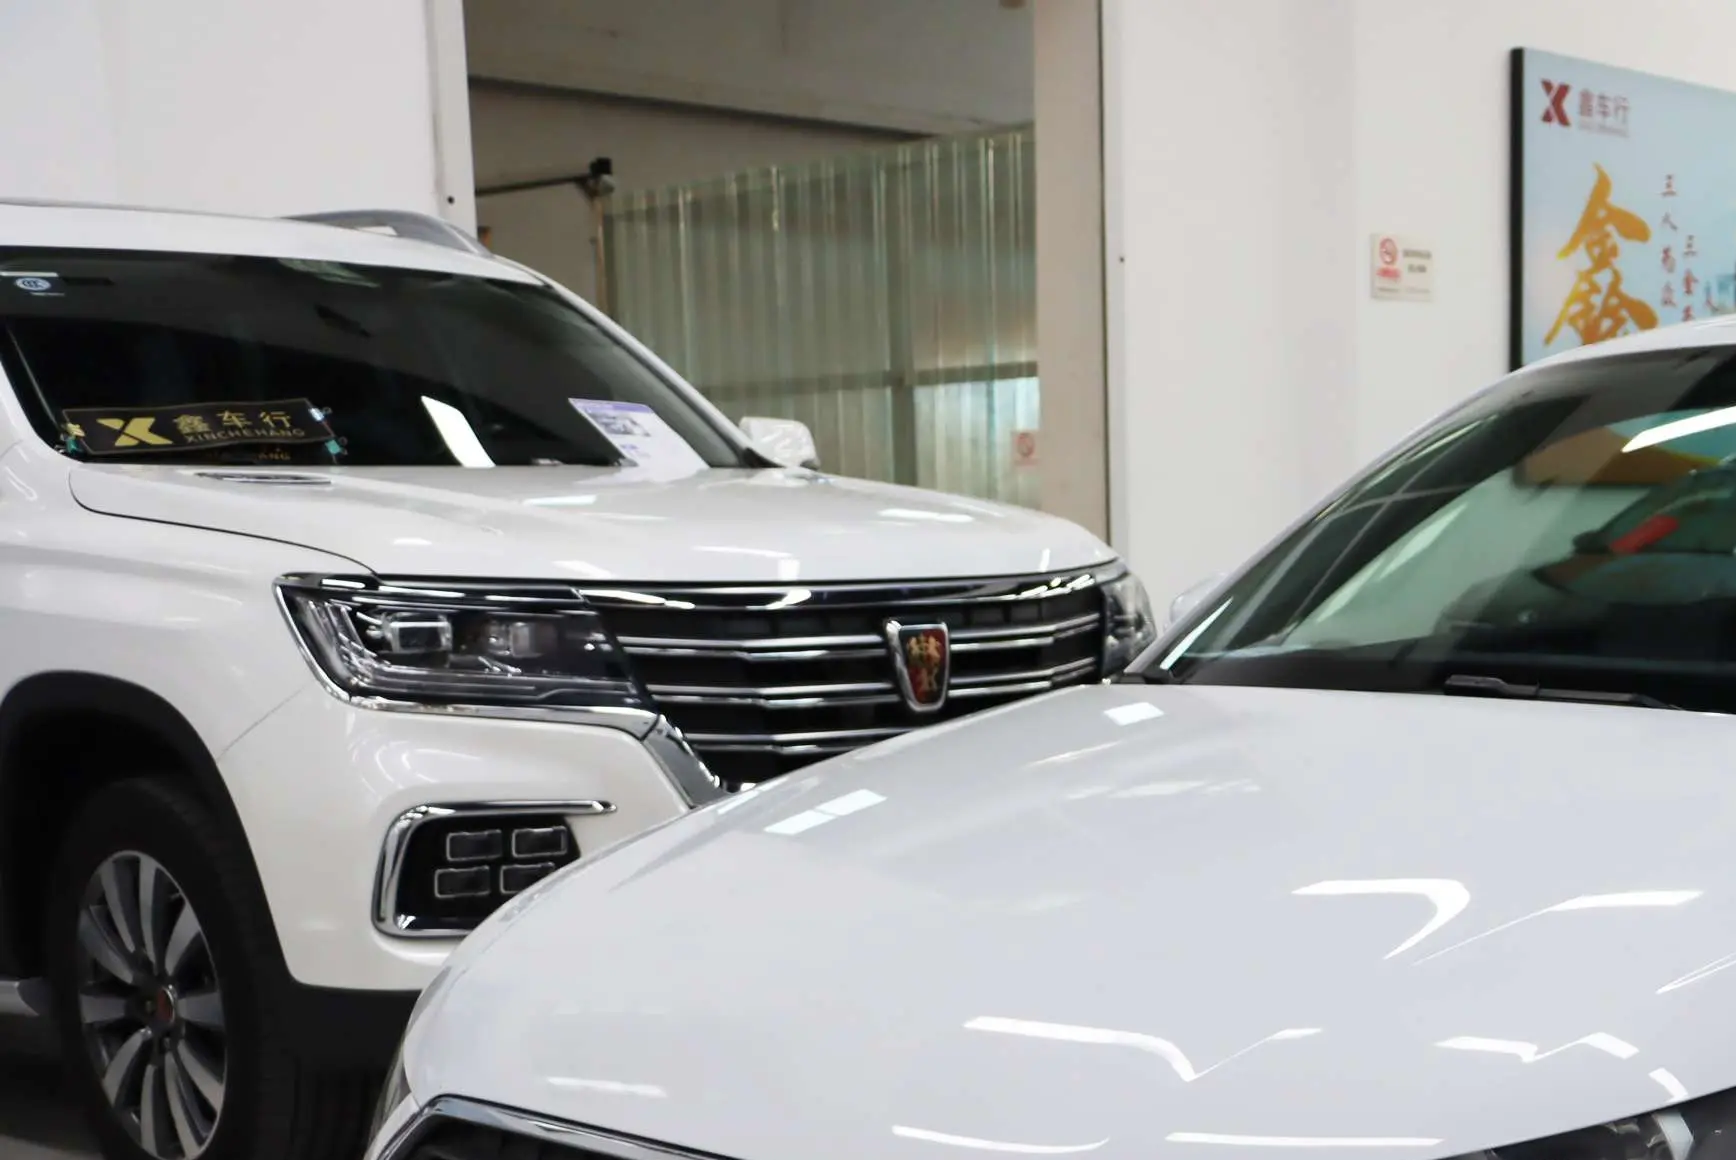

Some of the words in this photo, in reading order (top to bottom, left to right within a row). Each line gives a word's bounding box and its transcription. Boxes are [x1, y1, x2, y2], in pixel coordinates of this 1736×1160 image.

[173, 410, 292, 435] 鑫车行
[185, 427, 305, 446] XINCHEHANG
